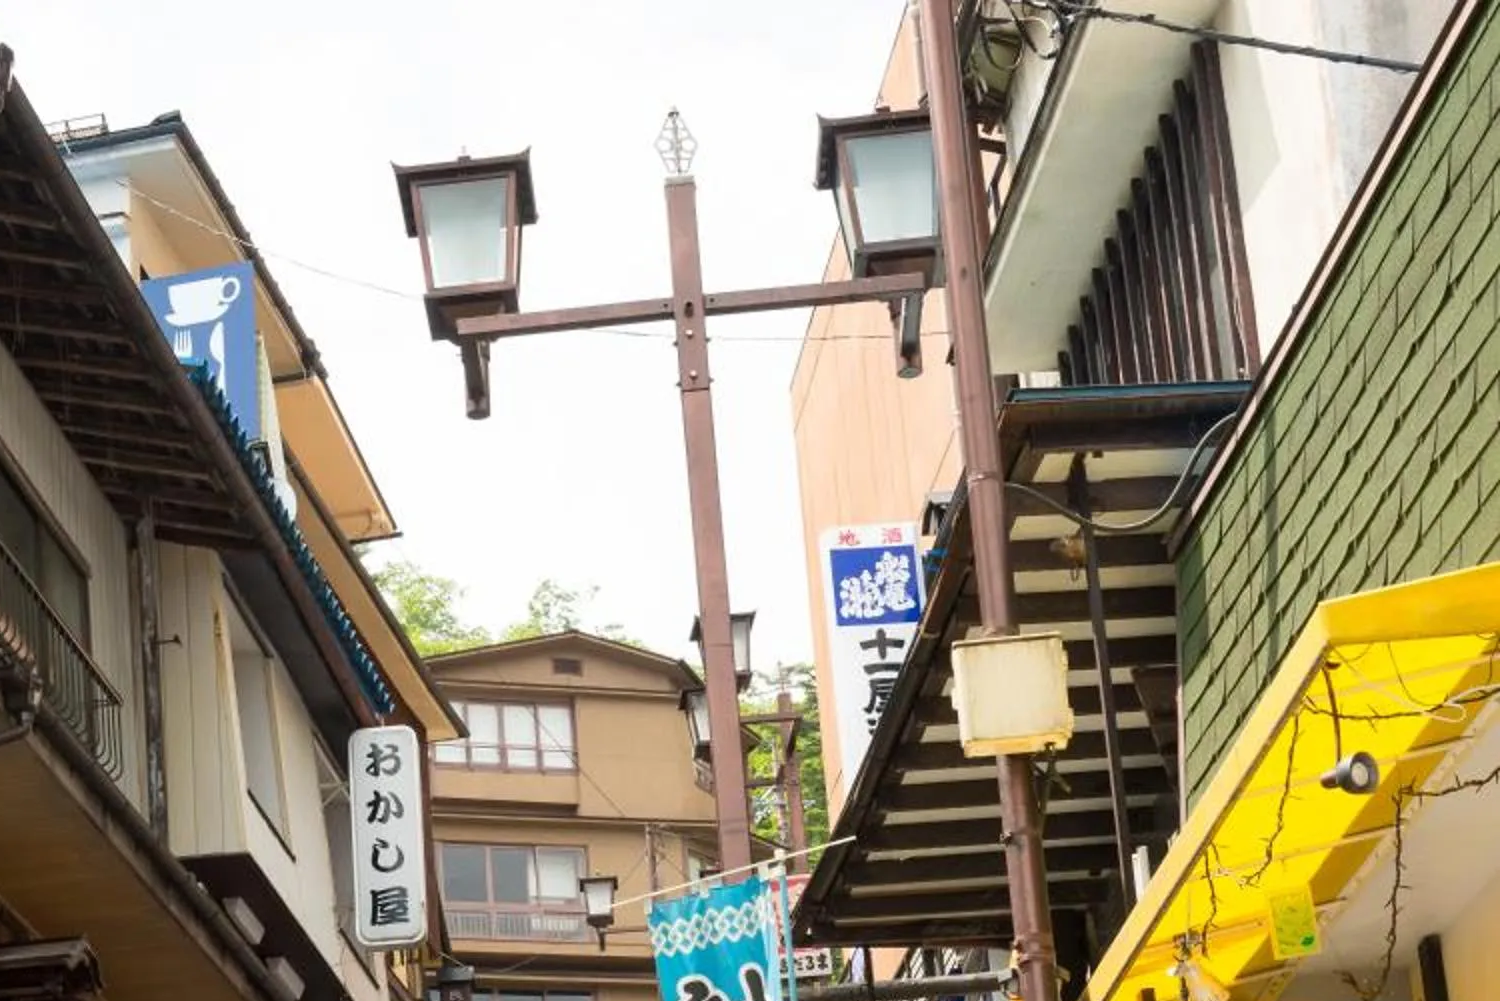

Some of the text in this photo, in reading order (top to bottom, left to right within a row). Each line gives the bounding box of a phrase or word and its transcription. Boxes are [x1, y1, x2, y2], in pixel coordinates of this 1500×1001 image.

[838, 527, 903, 546] 地酒
[363, 740, 411, 929] おかし屋
